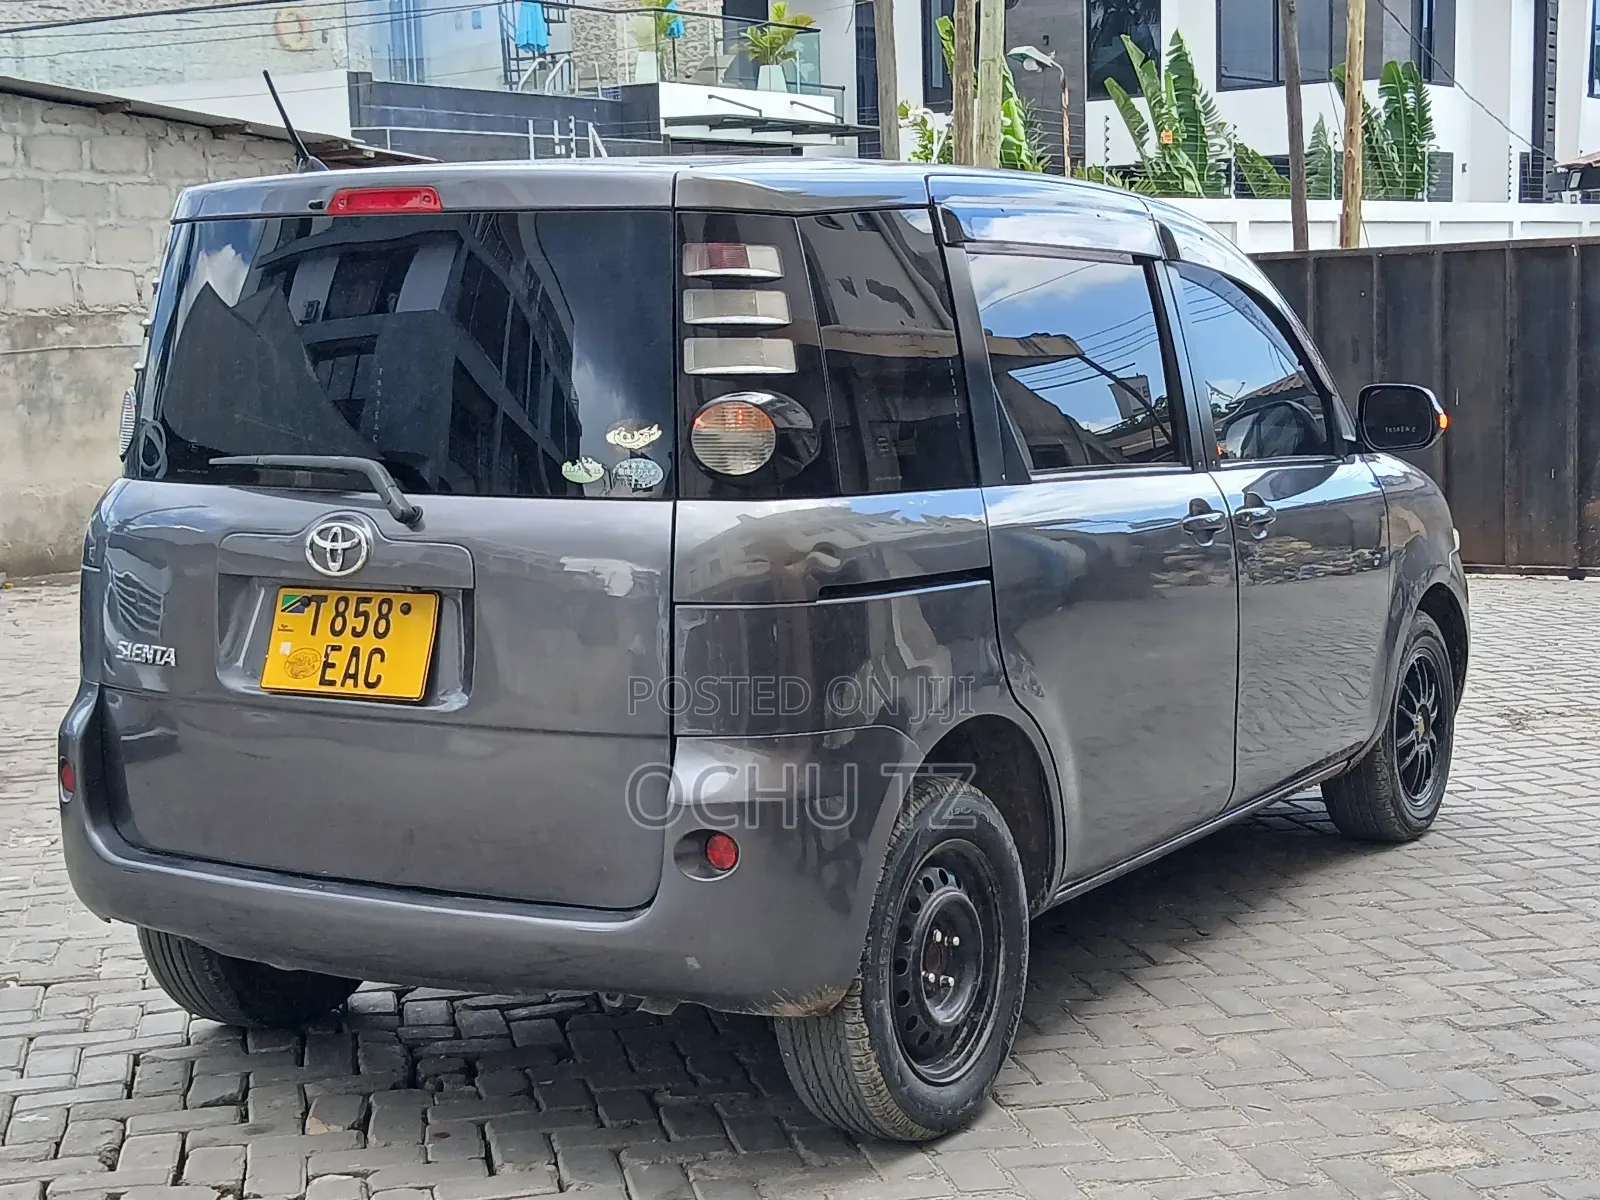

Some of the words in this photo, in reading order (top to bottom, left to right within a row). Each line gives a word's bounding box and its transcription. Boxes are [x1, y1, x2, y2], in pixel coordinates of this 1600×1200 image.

[309, 594, 394, 640] T858
[115, 640, 176, 667] SIENTA
[318, 644, 386, 689] EAC
